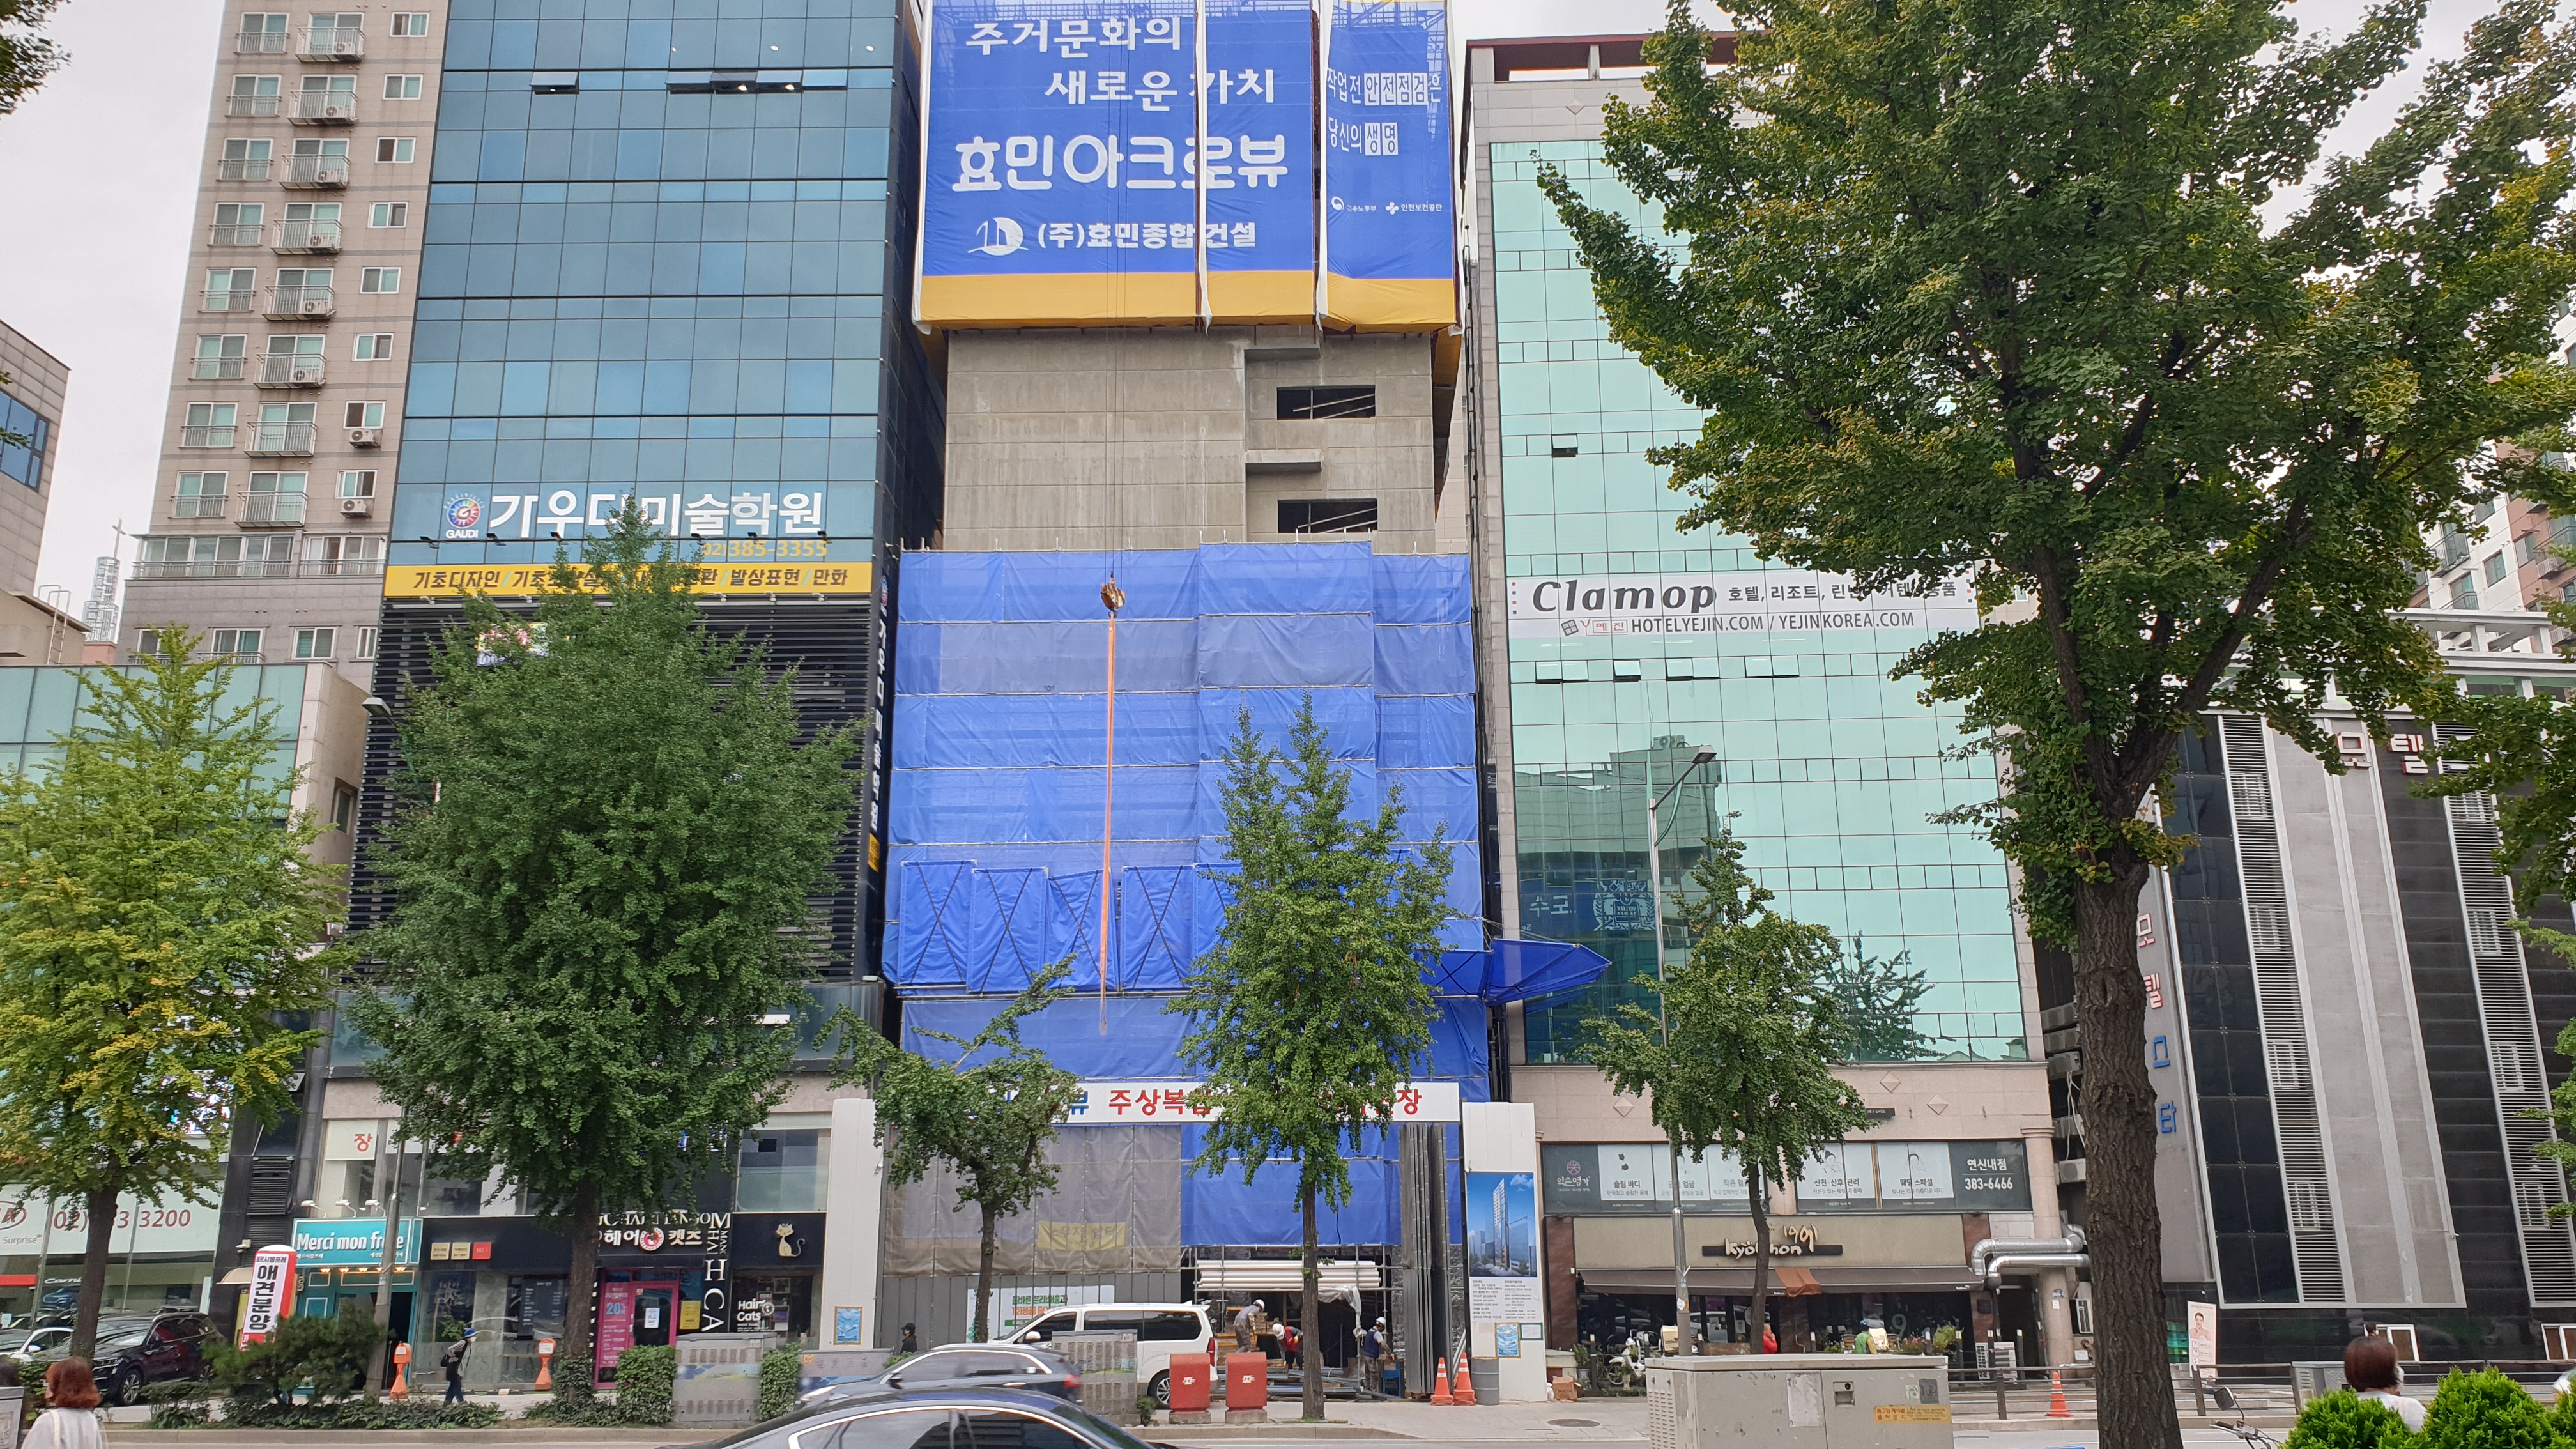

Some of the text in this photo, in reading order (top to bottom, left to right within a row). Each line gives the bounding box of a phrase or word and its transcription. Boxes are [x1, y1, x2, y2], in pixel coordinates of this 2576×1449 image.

[966, 19, 1181, 55] 주거문화의
[1045, 69, 1275, 112] 새로운 가치
[1327, 68, 1347, 102] 작업
[1328, 117, 1399, 155] 당신의 생명
[951, 135, 1289, 193] 효민아크로뷰
[1037, 222, 1257, 250] (주)효민종합건설
[445, 529, 479, 539] GAUDI
[414, 571, 500, 589] 기초디자인
[730, 569, 801, 586] 발상표현
[813, 569, 848, 586] 만화
[1532, 579, 1717, 614] Clamop
[1728, 586, 1766, 602] 호텔,
[1770, 585, 1826, 601] 리조트,
[1632, 617, 1764, 633] HOTELYEJIN.COM
[1779, 611, 1915, 630] YEJINKOREA.COM
[1966, 1158, 2007, 1172] 연신내점
[1557, 1176, 1590, 1186] 약손명가
[1614, 1179, 1641, 1188] 슬림 바디
[1847, 1178, 1860, 1186] 관리
[1965, 1177, 2013, 1190] 383-6466
[295, 1232, 334, 1251] Merci
[337, 1236, 367, 1251] mon
[604, 1229, 702, 1246] 헤어 캣즈
[249, 1264, 279, 1330] 애견분양
[738, 1298, 766, 1310] Hair
[737, 1311, 762, 1321] Cats
